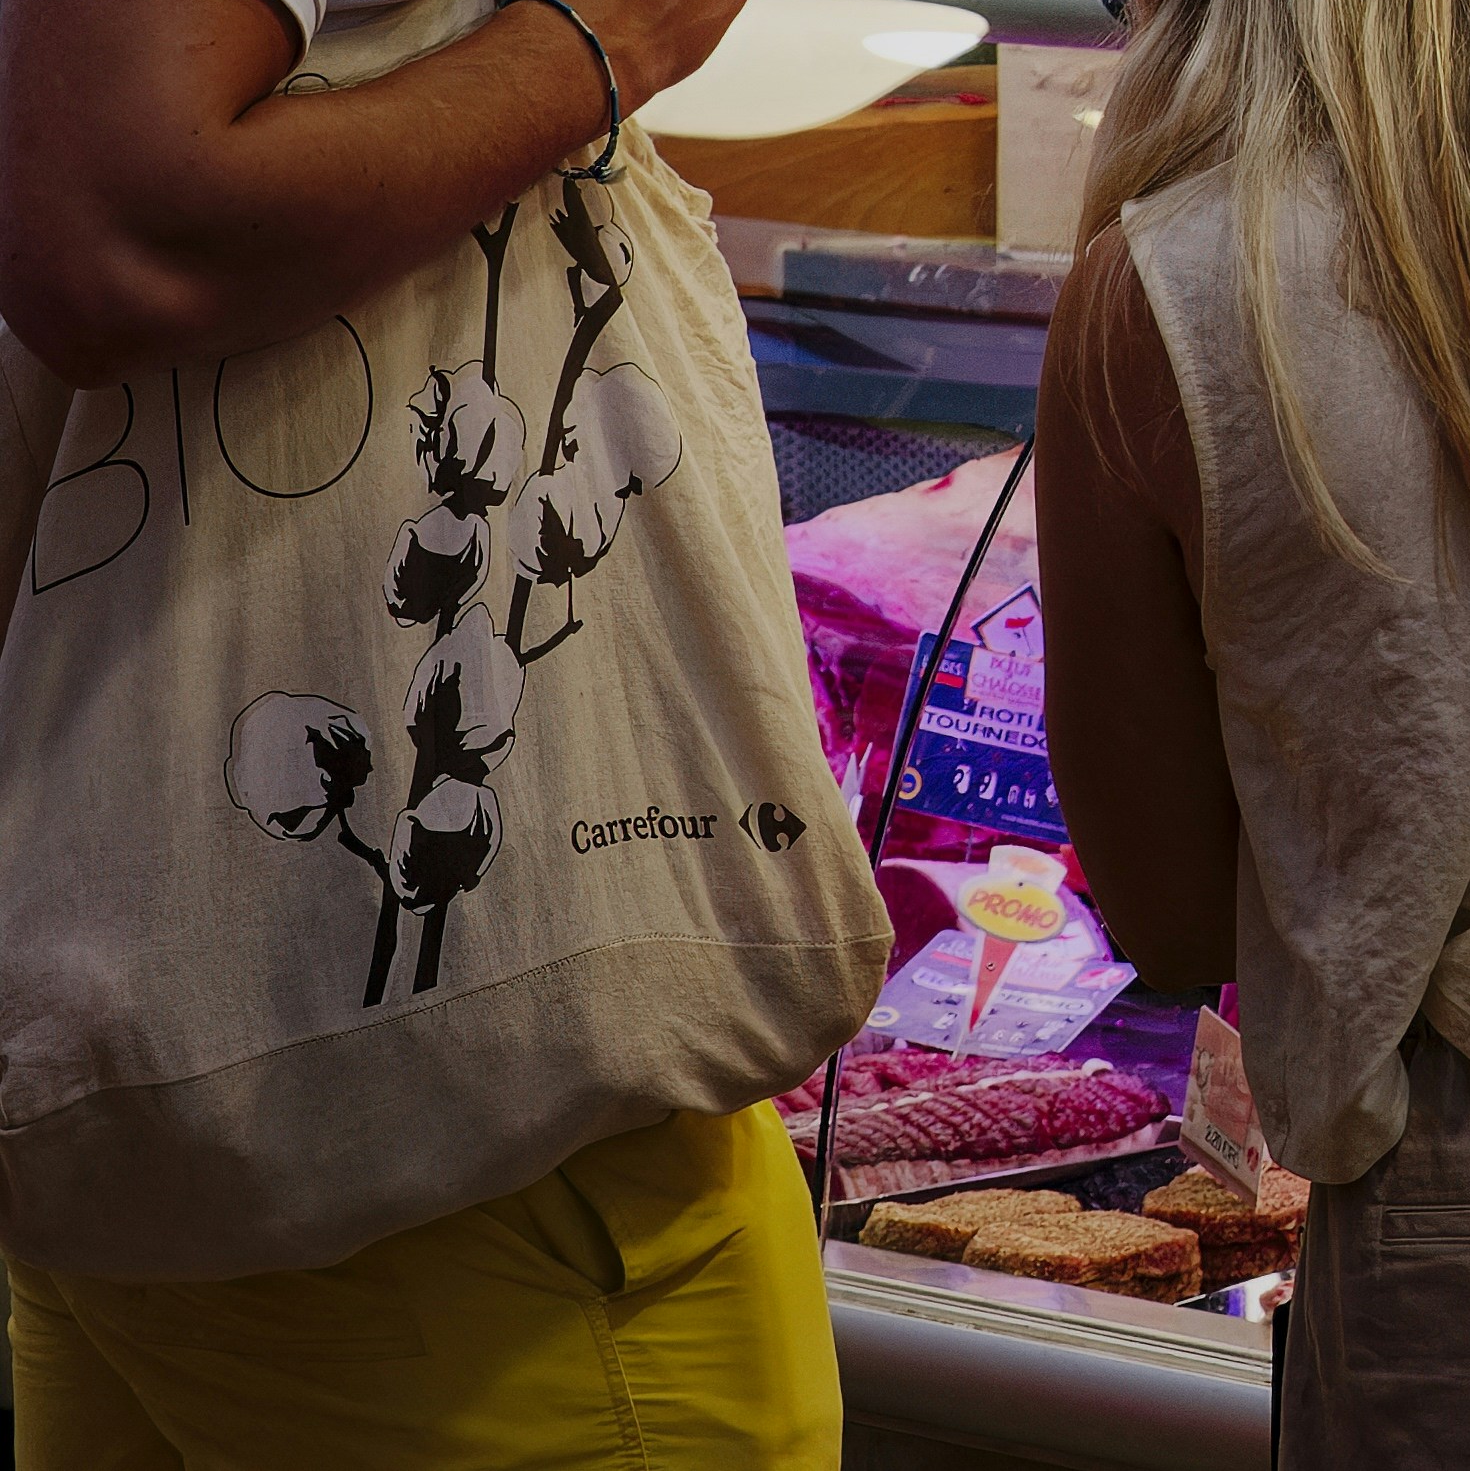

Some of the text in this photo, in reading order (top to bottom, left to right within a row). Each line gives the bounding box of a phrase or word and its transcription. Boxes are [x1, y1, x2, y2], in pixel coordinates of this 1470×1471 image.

[978, 706, 1033, 728] ROTI
[571, 805, 718, 855] Carrefour
[967, 888, 1059, 930] PROMO
